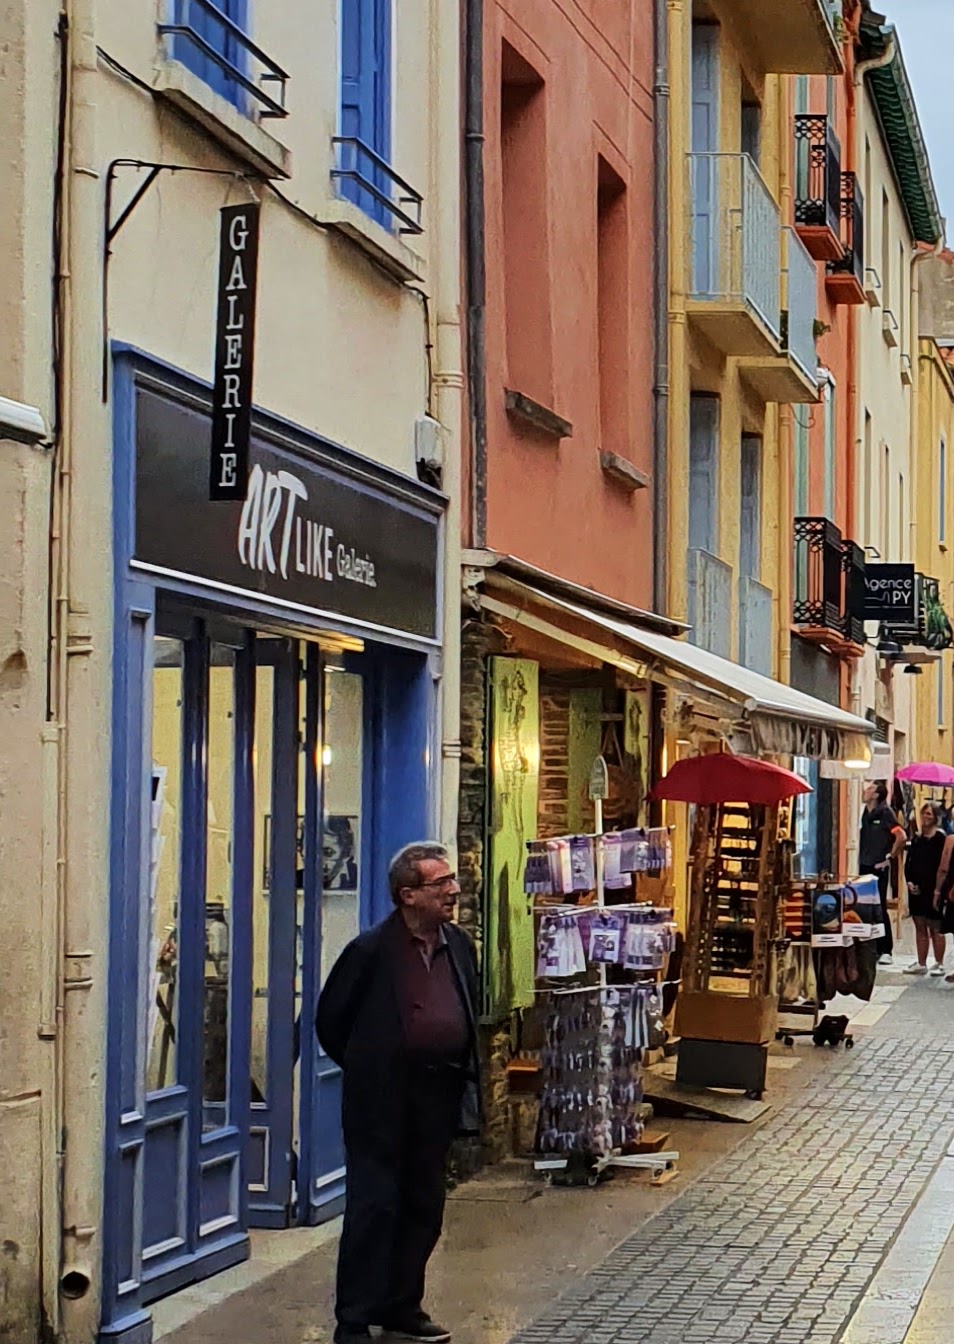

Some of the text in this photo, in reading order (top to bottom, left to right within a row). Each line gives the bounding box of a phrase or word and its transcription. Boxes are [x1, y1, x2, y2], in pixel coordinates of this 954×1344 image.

[218, 215, 249, 487] GALERIE
[238, 464, 377, 587] ART LIKE Galerie
[892, 590, 911, 604] PY
